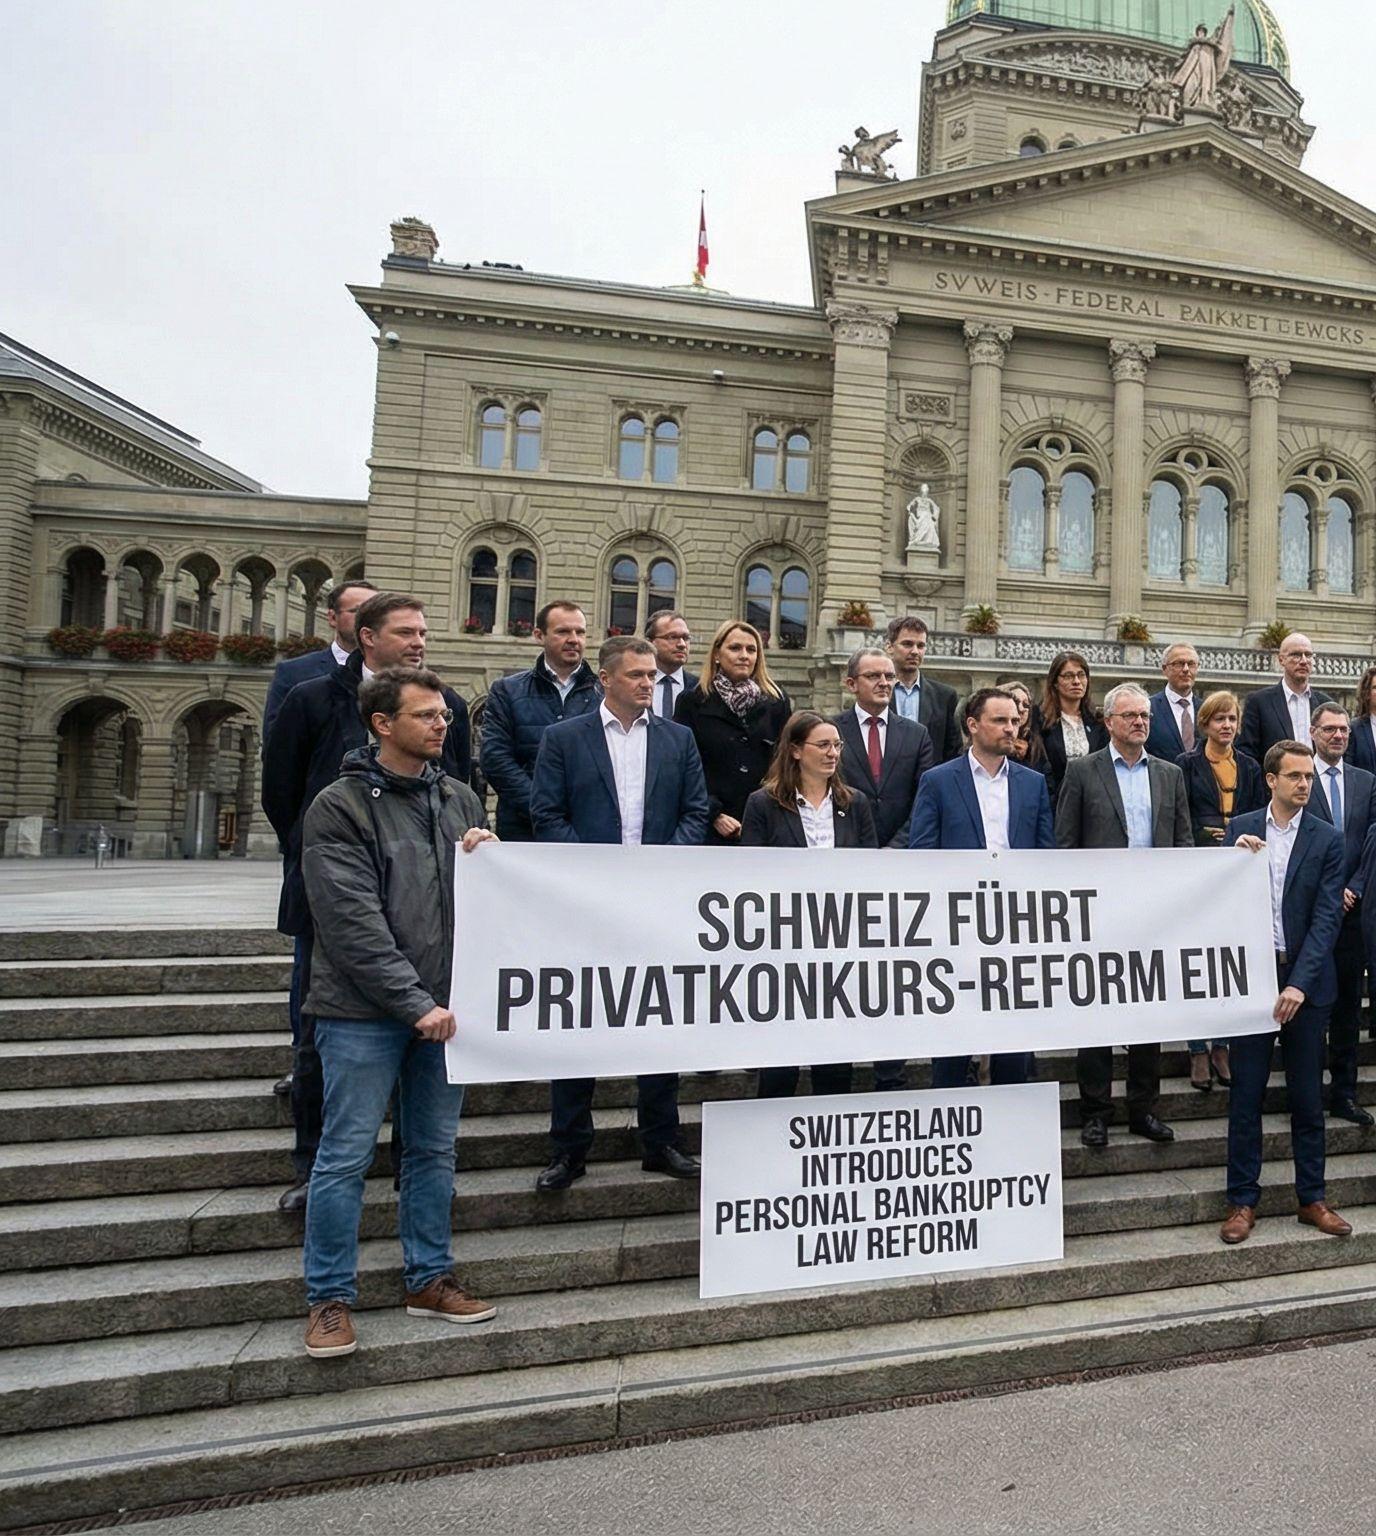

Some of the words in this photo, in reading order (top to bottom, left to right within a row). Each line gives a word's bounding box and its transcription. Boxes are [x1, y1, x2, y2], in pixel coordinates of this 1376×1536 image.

[1056, 287, 1165, 318] FEDERAL
[699, 892, 932, 952] SCHWEIZ
[949, 881, 1098, 945] FÜHRT
[497, 949, 1167, 1032] PRIVATKONKURS-REFORM
[1181, 946, 1248, 1000] EIN
[790, 1105, 982, 1149] SWITZERLAND
[803, 1142, 973, 1188] INTRODUCES
[715, 1190, 867, 1235] PERSONAL
[875, 1174, 1051, 1221] BANKRUPTCY
[798, 1230, 858, 1268] LAW
[868, 1218, 978, 1261] REFORM
